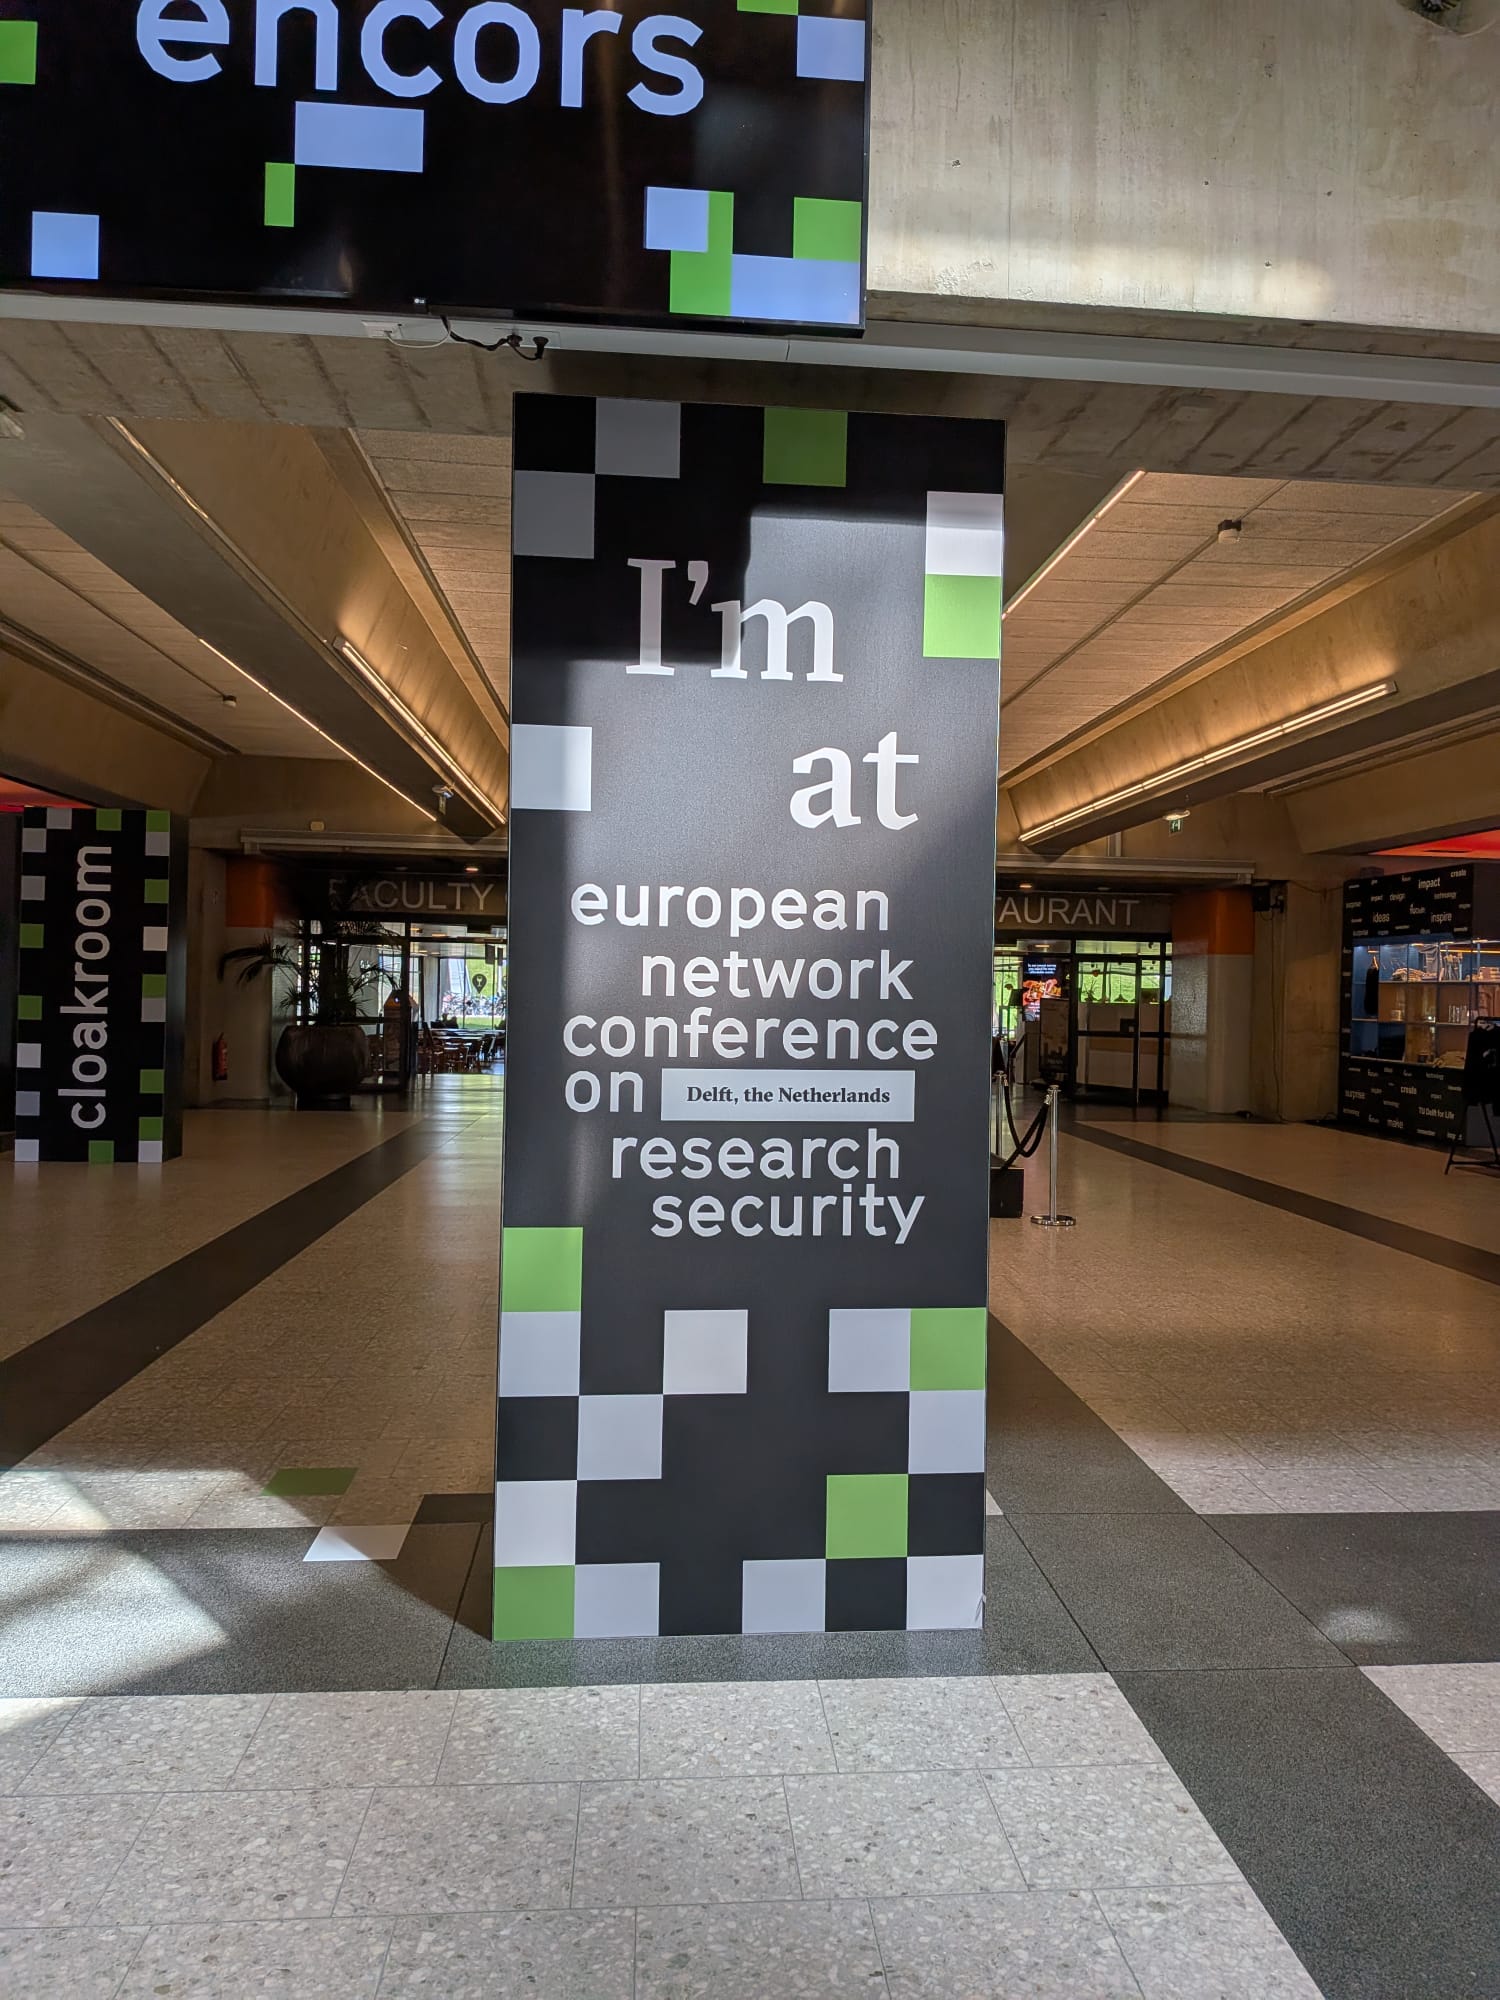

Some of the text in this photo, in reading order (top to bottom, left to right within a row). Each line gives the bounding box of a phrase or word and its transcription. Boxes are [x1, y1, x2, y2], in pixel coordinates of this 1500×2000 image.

[136, 0, 704, 116] encors
[625, 557, 844, 683] I’m
[789, 731, 920, 831] at
[328, 878, 495, 912] FACULTY
[1418, 877, 1441, 890] impact
[570, 882, 889, 938] european
[996, 895, 1140, 926] AURANT
[1372, 912, 1391, 924] ideas
[1430, 912, 1453, 925] inspire
[57, 845, 112, 1129] cloakroom
[641, 949, 914, 1000] network
[563, 1006, 938, 1060] conference
[565, 1070, 644, 1113] on
[686, 1086, 890, 1105] Delft, the Netherlands
[612, 1128, 900, 1180] research
[650, 1183, 925, 1245] security
